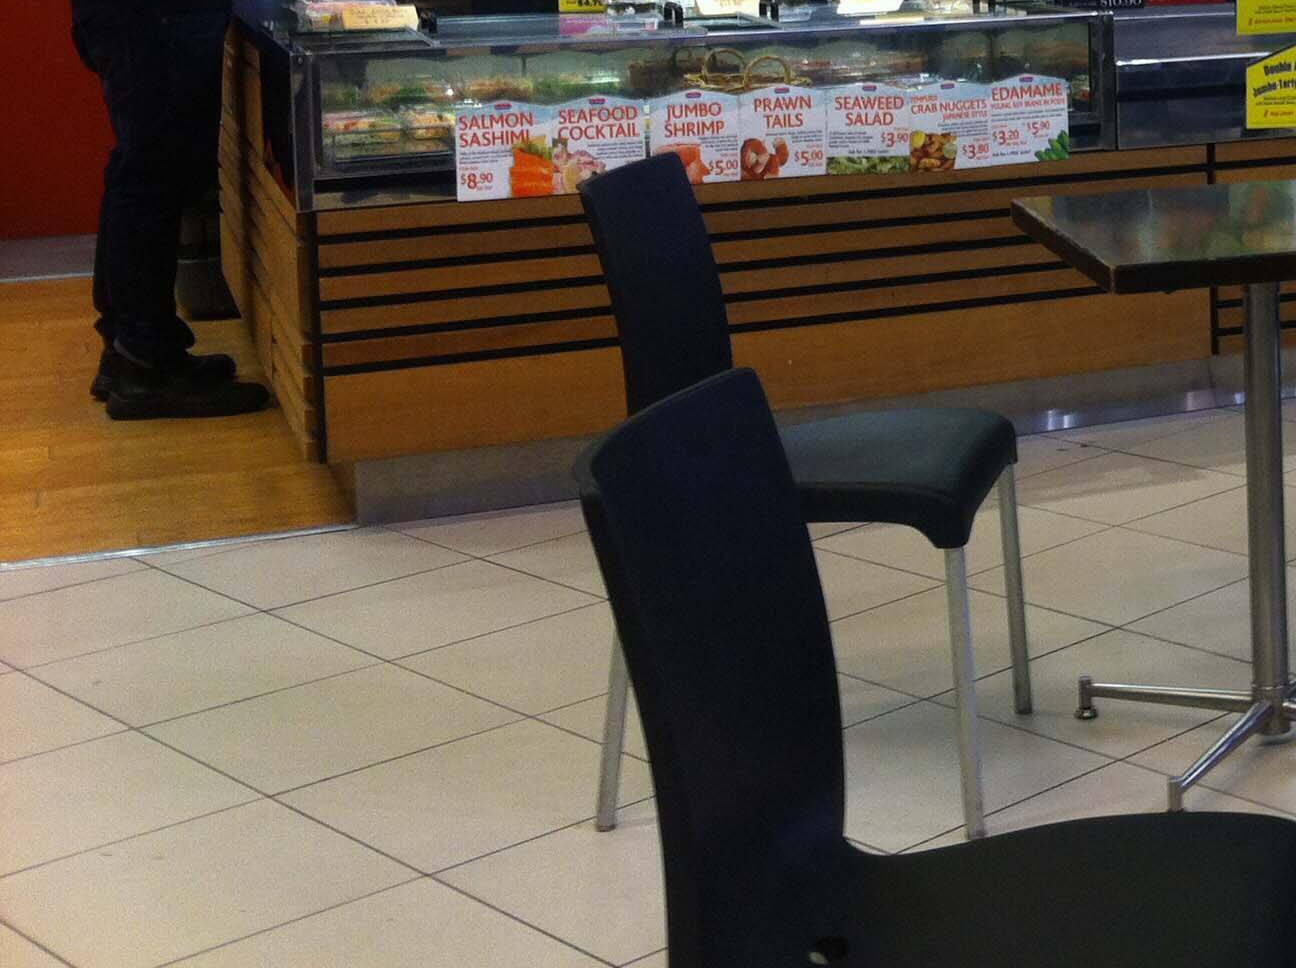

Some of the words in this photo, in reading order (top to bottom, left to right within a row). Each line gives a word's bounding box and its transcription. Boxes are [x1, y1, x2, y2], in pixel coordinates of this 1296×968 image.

[991, 83, 1063, 102] EDAMAME
[754, 95, 812, 113] PRAWN
[834, 95, 904, 110] SEAWEED
[911, 103, 938, 115] CRAB
[939, 98, 988, 113] NUGGETS
[558, 105, 638, 125] SEAFOOD
[667, 102, 722, 122] JUMBO
[764, 112, 804, 129] TAILS
[845, 112, 894, 126] SALAD
[459, 112, 533, 131] SALMON
[664, 120, 724, 138] SHRIMP
[459, 129, 529, 148] SASHIMI
[558, 123, 640, 140] COCKTAIL
